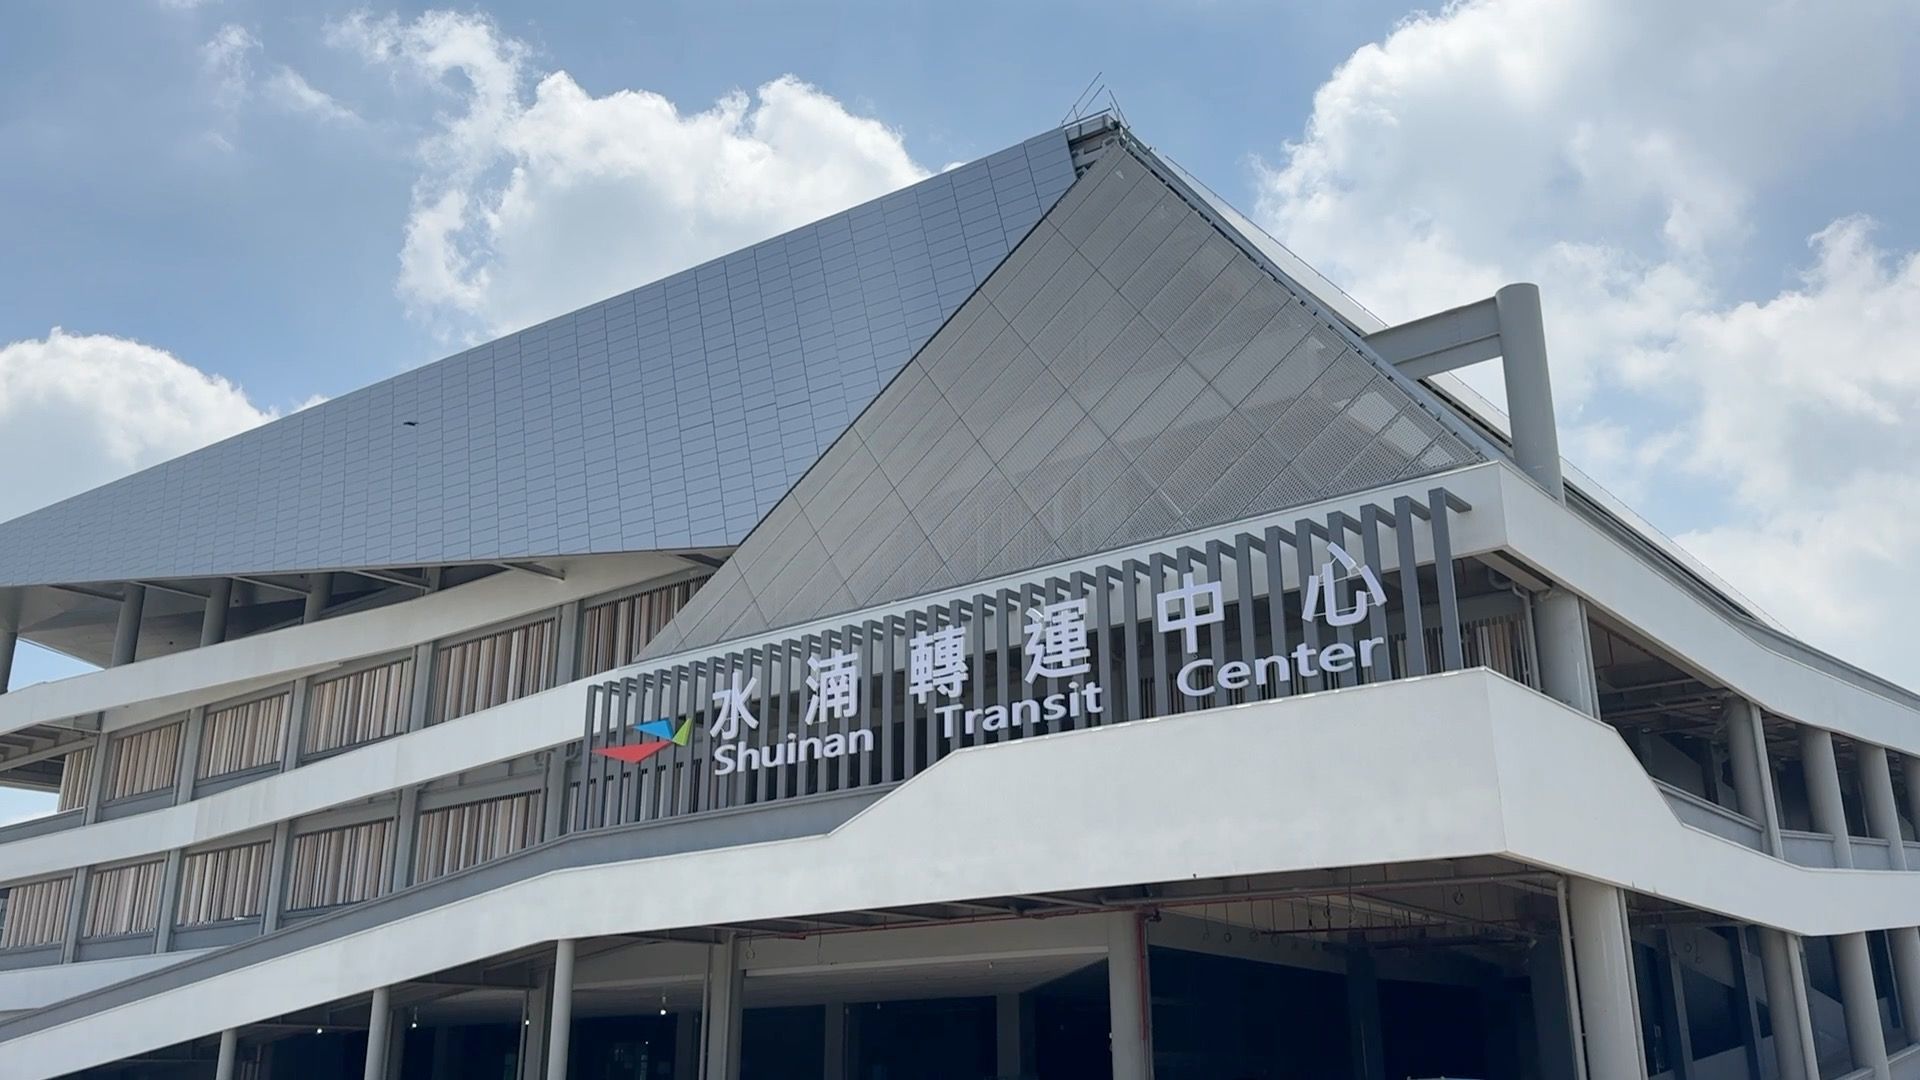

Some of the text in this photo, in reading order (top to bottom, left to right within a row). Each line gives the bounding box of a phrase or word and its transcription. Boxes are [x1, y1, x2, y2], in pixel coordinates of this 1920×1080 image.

[709, 542, 1386, 739] 水湳轉運中心
[713, 636, 1384, 776] Shuinan Transit Center
